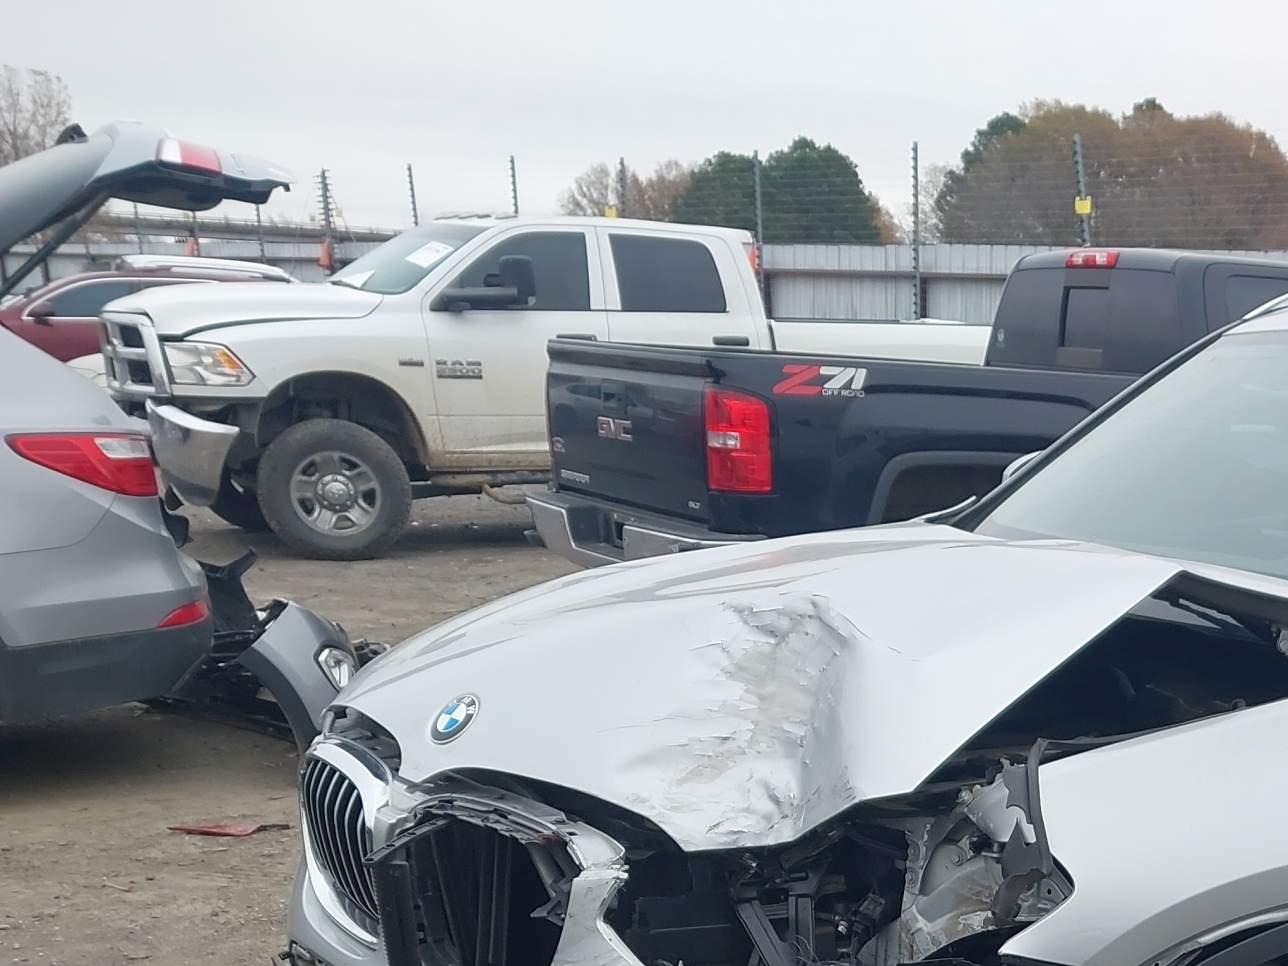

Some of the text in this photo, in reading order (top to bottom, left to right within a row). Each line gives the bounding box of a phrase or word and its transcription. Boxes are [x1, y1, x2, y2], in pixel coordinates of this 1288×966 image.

[773, 364, 868, 394] Z71
[822, 388, 865, 398] OFF ROAD
[597, 416, 633, 442] GMC
